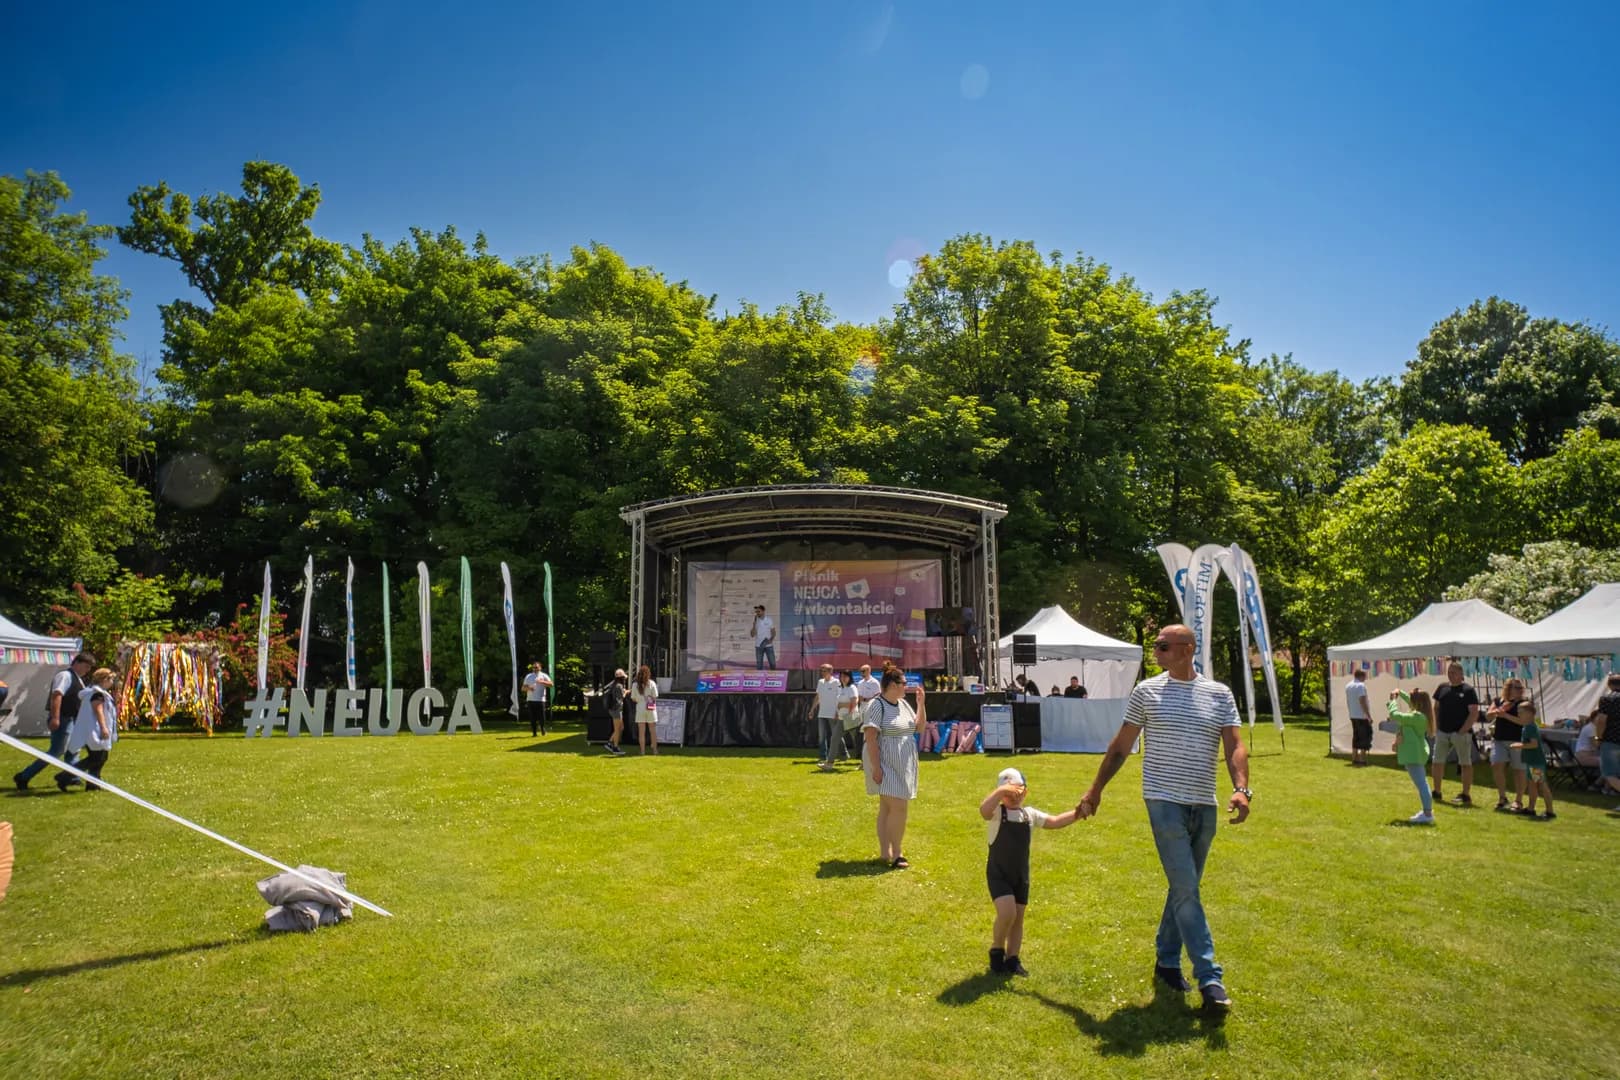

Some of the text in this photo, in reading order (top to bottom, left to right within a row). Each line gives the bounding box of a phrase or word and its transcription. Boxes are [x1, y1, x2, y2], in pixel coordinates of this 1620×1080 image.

[794, 570, 839, 583] Piknik
[793, 585, 841, 600] NEUCA
[794, 601, 895, 615] #wkontakcie
[243, 687, 483, 738] #NEUCA
